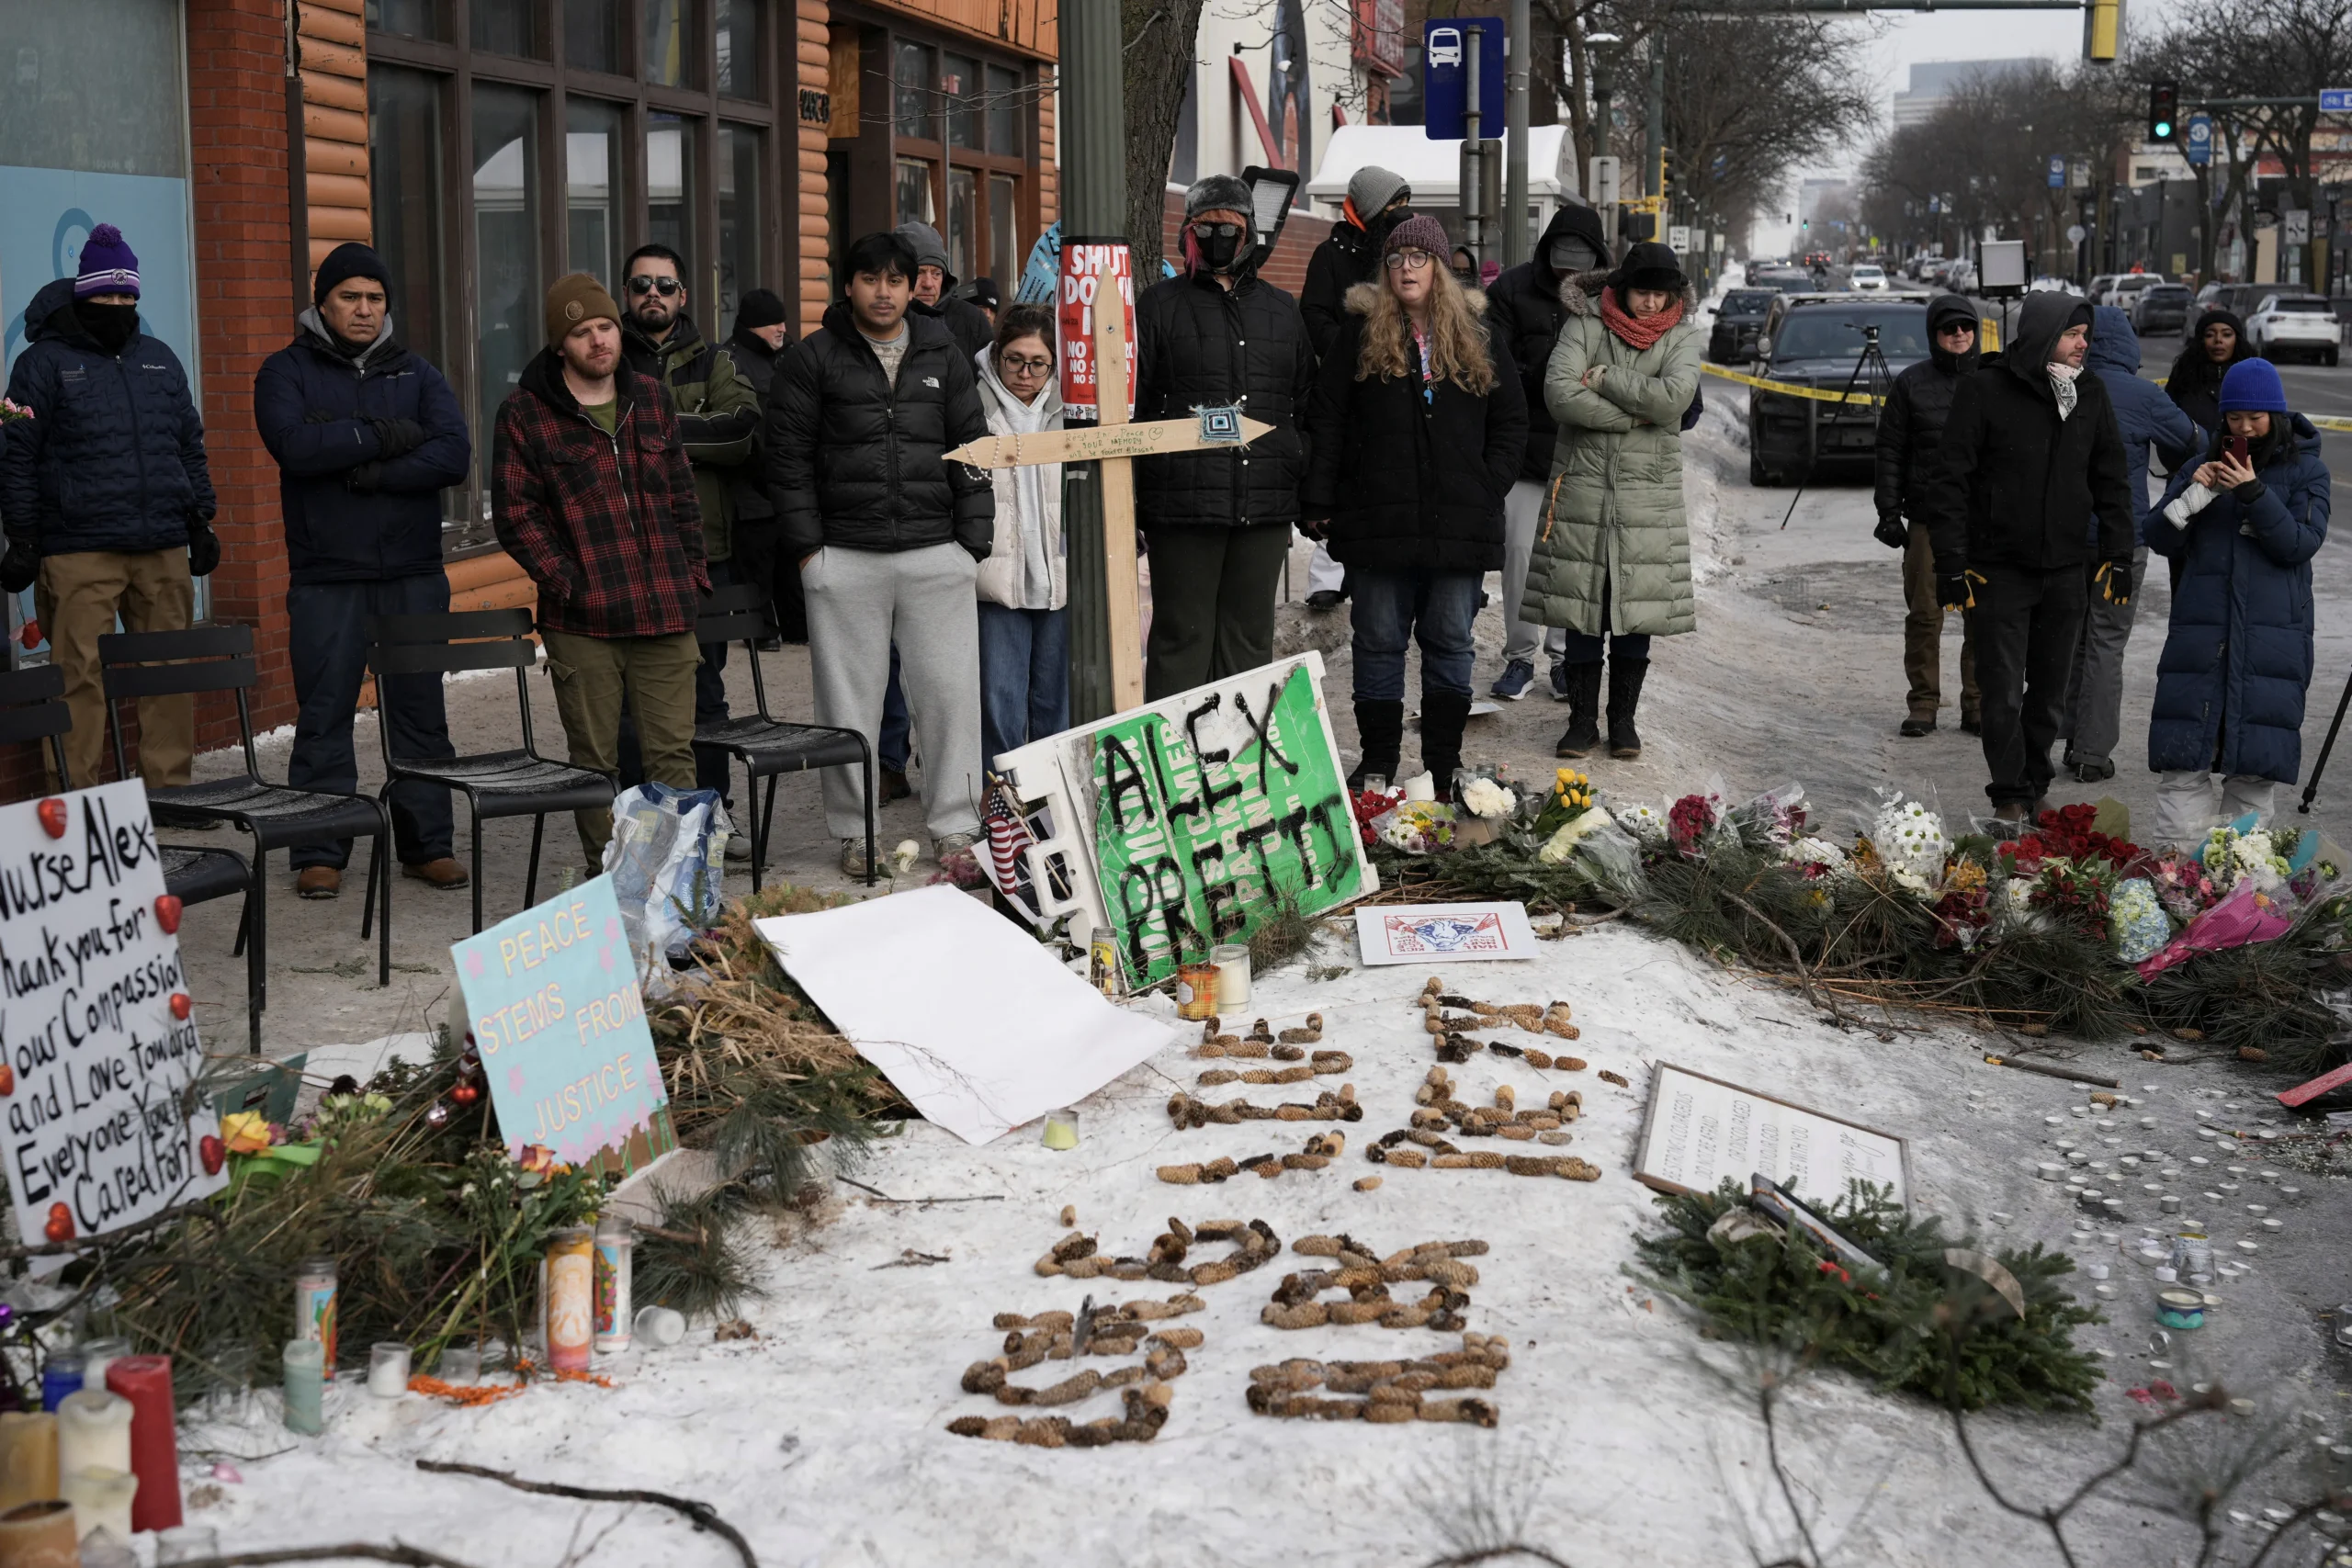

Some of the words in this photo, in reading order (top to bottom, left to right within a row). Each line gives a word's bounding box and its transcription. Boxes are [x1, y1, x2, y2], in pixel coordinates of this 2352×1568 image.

[1070, 244, 1127, 276] SHUT
[1067, 341, 1087, 359] NO
[1069, 359, 1087, 373] NO
[1073, 374, 1086, 384] NO
[1102, 682, 1300, 836] ALEX
[0, 926, 66, 999] hank
[65, 927, 111, 988] you
[107, 898, 146, 953] for
[500, 901, 593, 976] PEACE
[478, 982, 566, 1055] STEMS
[575, 978, 647, 1046] FROM
[9, 1074, 62, 1135] and
[65, 1056, 133, 1114] Love
[534, 1053, 639, 1141] JUSTICE
[1670, 1090, 1694, 1138] COURAGEOUS
[1700, 1115, 1719, 1142] AFRAID
[1728, 1100, 1752, 1152] DISCOURAGED
[1698, 1139, 1717, 1153] BE
[1760, 1122, 1780, 1142] GOD
[1791, 1124, 1809, 1145] YOU
[17, 1111, 136, 1206] Everyone
[1663, 1139, 1687, 1173] STRONG
[1727, 1148, 1747, 1163] OR
[1759, 1140, 1779, 1164] YOUR
[1790, 1142, 1809, 1164] WITH
[75, 1131, 157, 1234] Cared
[1694, 1166, 1714, 1181] DO
[1790, 1162, 1808, 1175] BE
